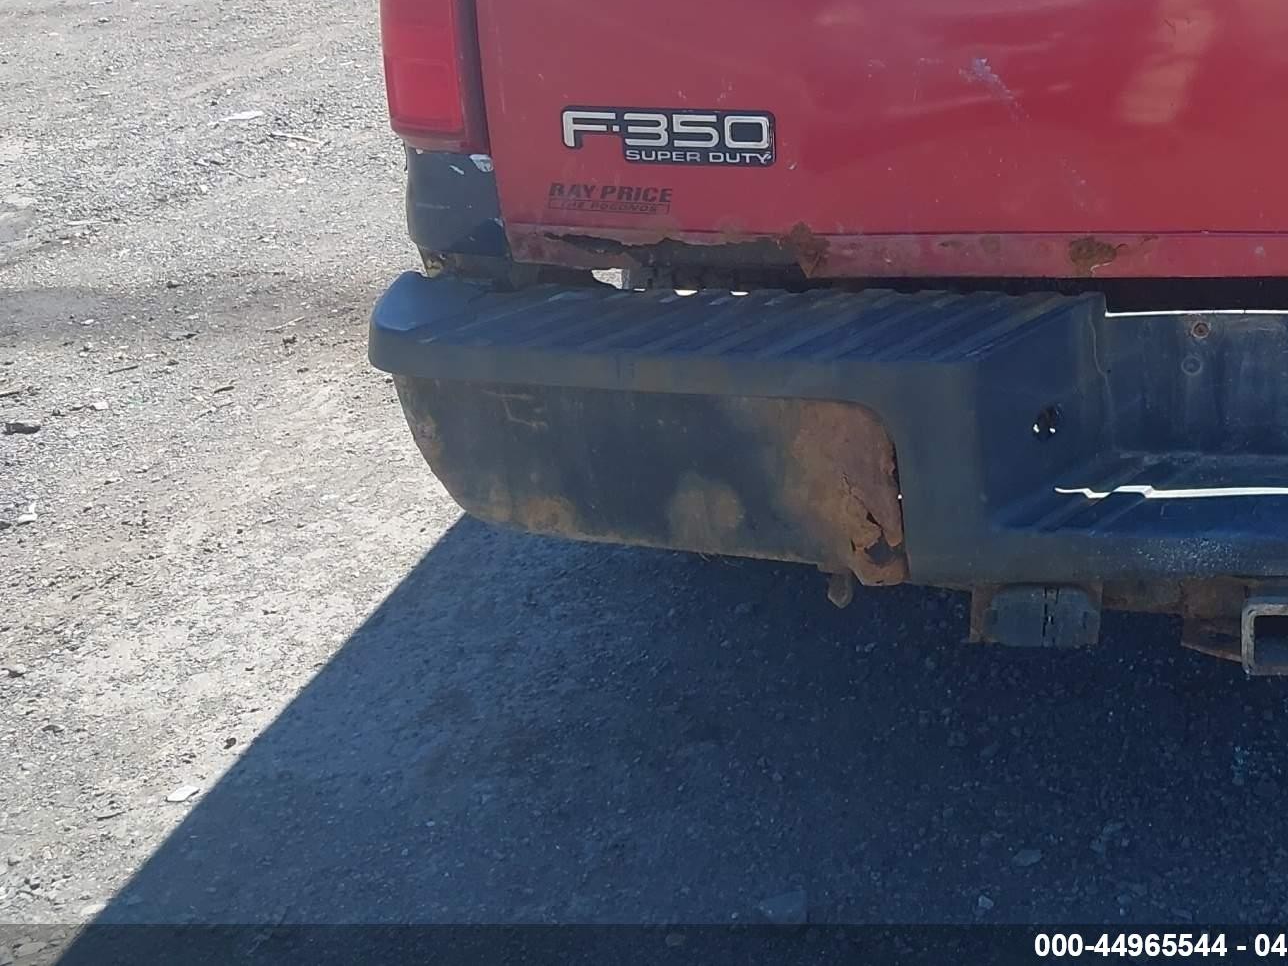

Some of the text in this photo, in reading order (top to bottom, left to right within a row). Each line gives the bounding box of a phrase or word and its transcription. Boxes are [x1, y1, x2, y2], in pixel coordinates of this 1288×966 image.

[625, 149, 772, 164] SUPER DUTY
[549, 183, 673, 203] RAY PRICE
